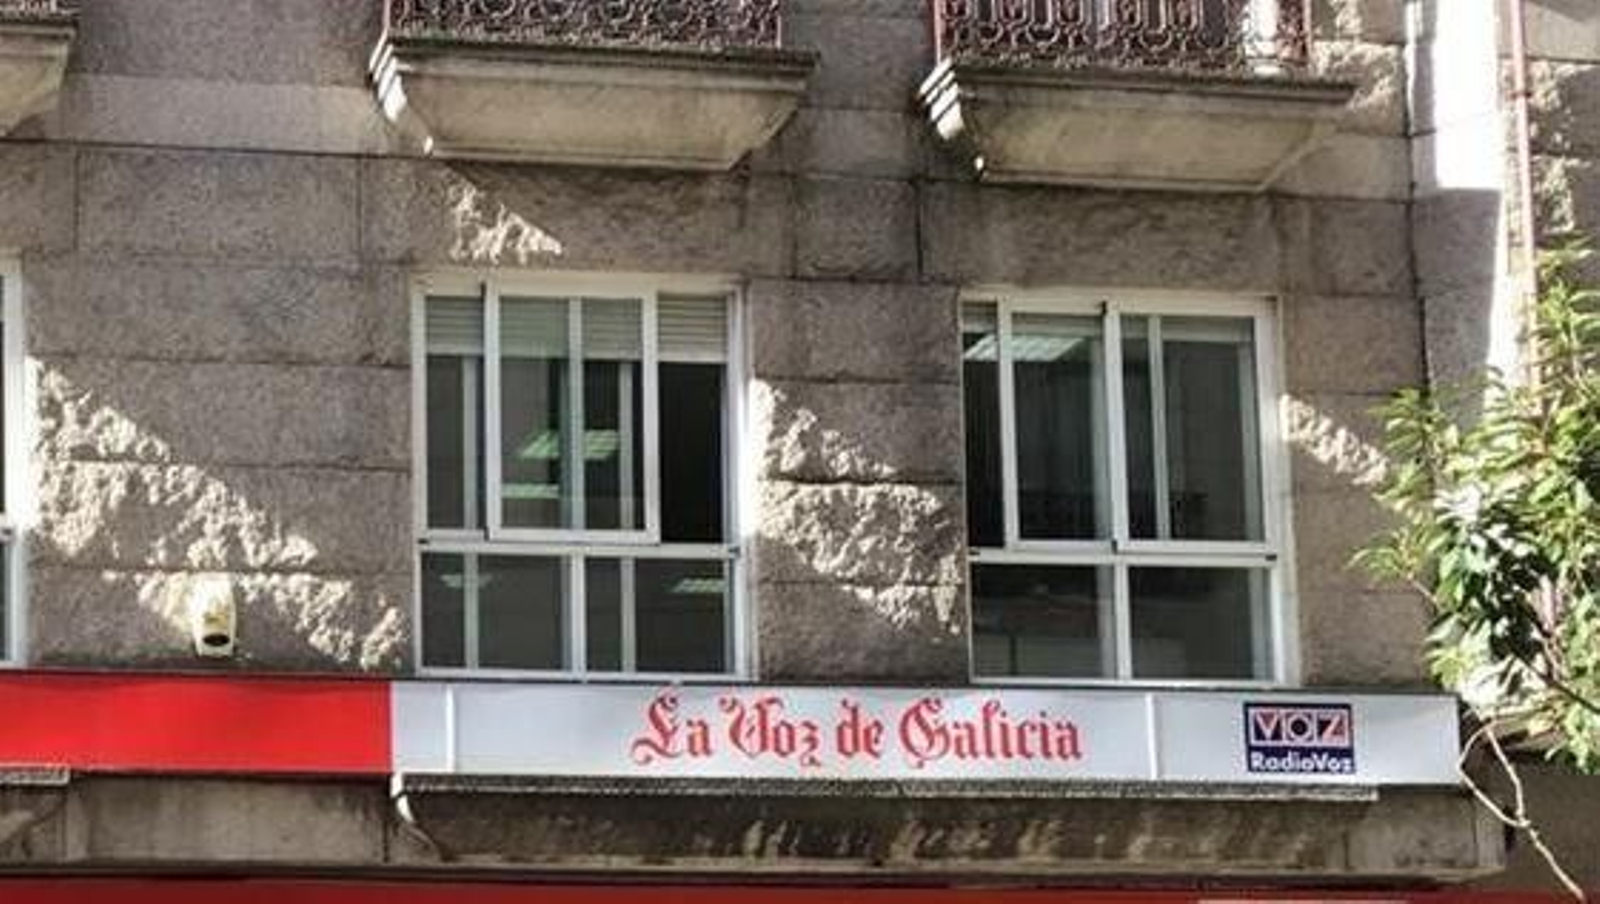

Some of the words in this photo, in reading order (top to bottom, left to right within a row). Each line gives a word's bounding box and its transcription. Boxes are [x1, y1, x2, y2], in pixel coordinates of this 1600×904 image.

[631, 692, 712, 766] La
[719, 695, 822, 767] Voz
[836, 699, 883, 760] de
[900, 696, 1082, 768] Galicia
[1252, 709, 1348, 745] VOZ
[1251, 751, 1354, 772] RadioVoz
